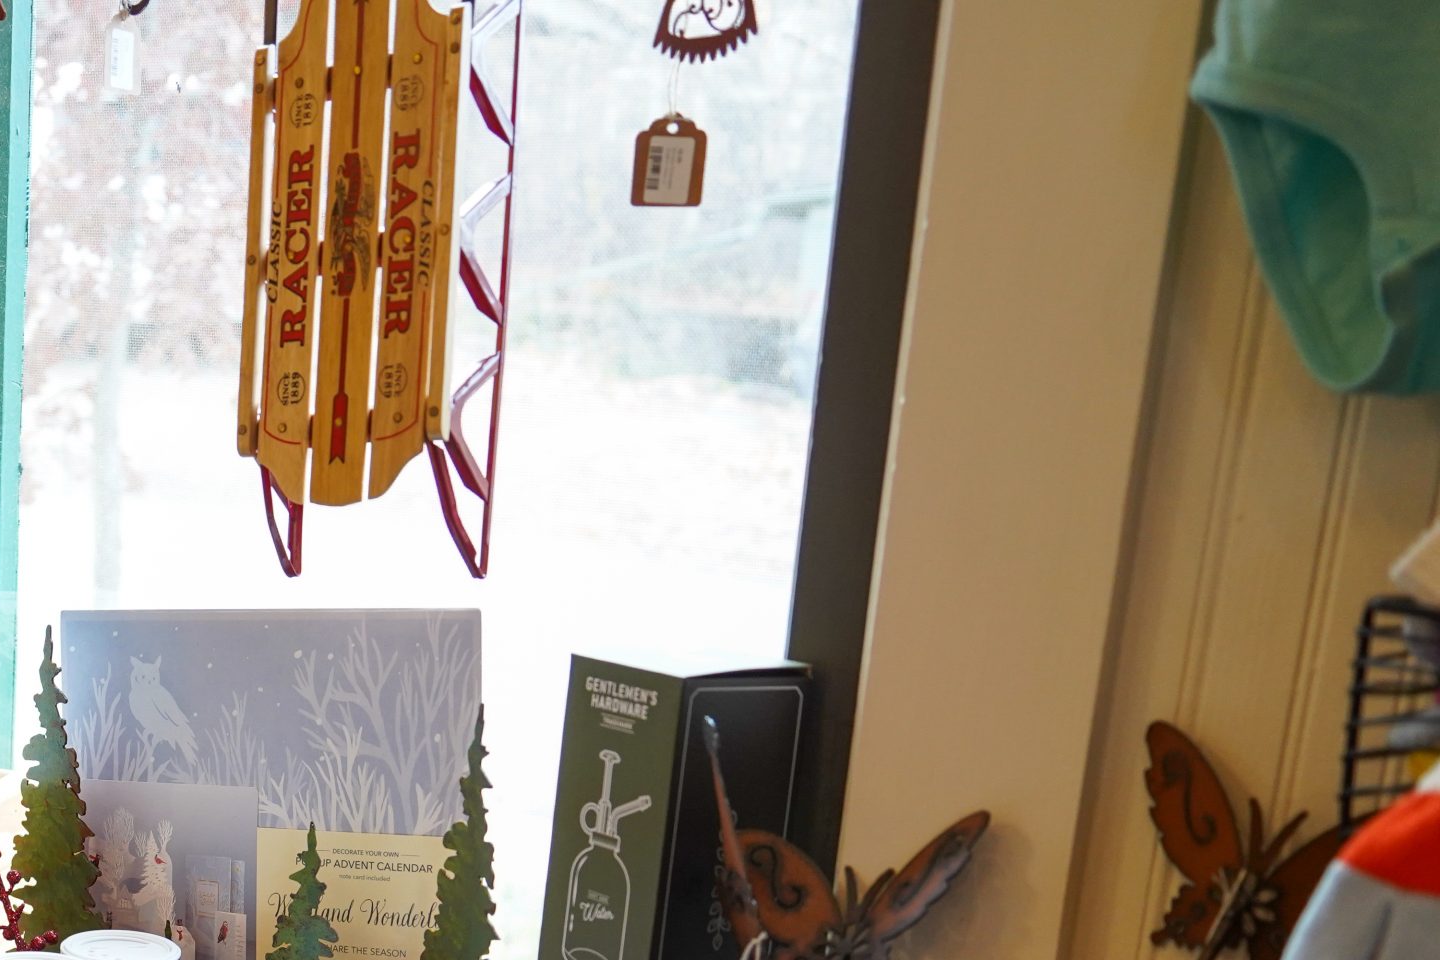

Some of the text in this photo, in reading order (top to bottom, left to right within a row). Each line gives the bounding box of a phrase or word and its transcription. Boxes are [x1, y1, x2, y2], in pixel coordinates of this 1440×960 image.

[303, 94, 313, 127] 1889
[400, 77, 410, 111] 1889
[296, 94, 304, 128] SINCE
[280, 144, 314, 348] RACER
[384, 128, 420, 339] RACER
[418, 180, 434, 287] CLASSIC
[267, 201, 282, 304] CLASSIC
[282, 372, 291, 405] SINCE
[290, 371, 301, 405] 1889
[384, 365, 394, 398] 1889
[585, 676, 659, 706] GENTLEMEN'S
[590, 694, 650, 720] HARDWARE
[332, 848, 400, 859] DECORATE YOUR OWN
[333, 861, 433, 874] ADVENT CALENDAR
[328, 945, 408, 958] HARE THE SEASON
